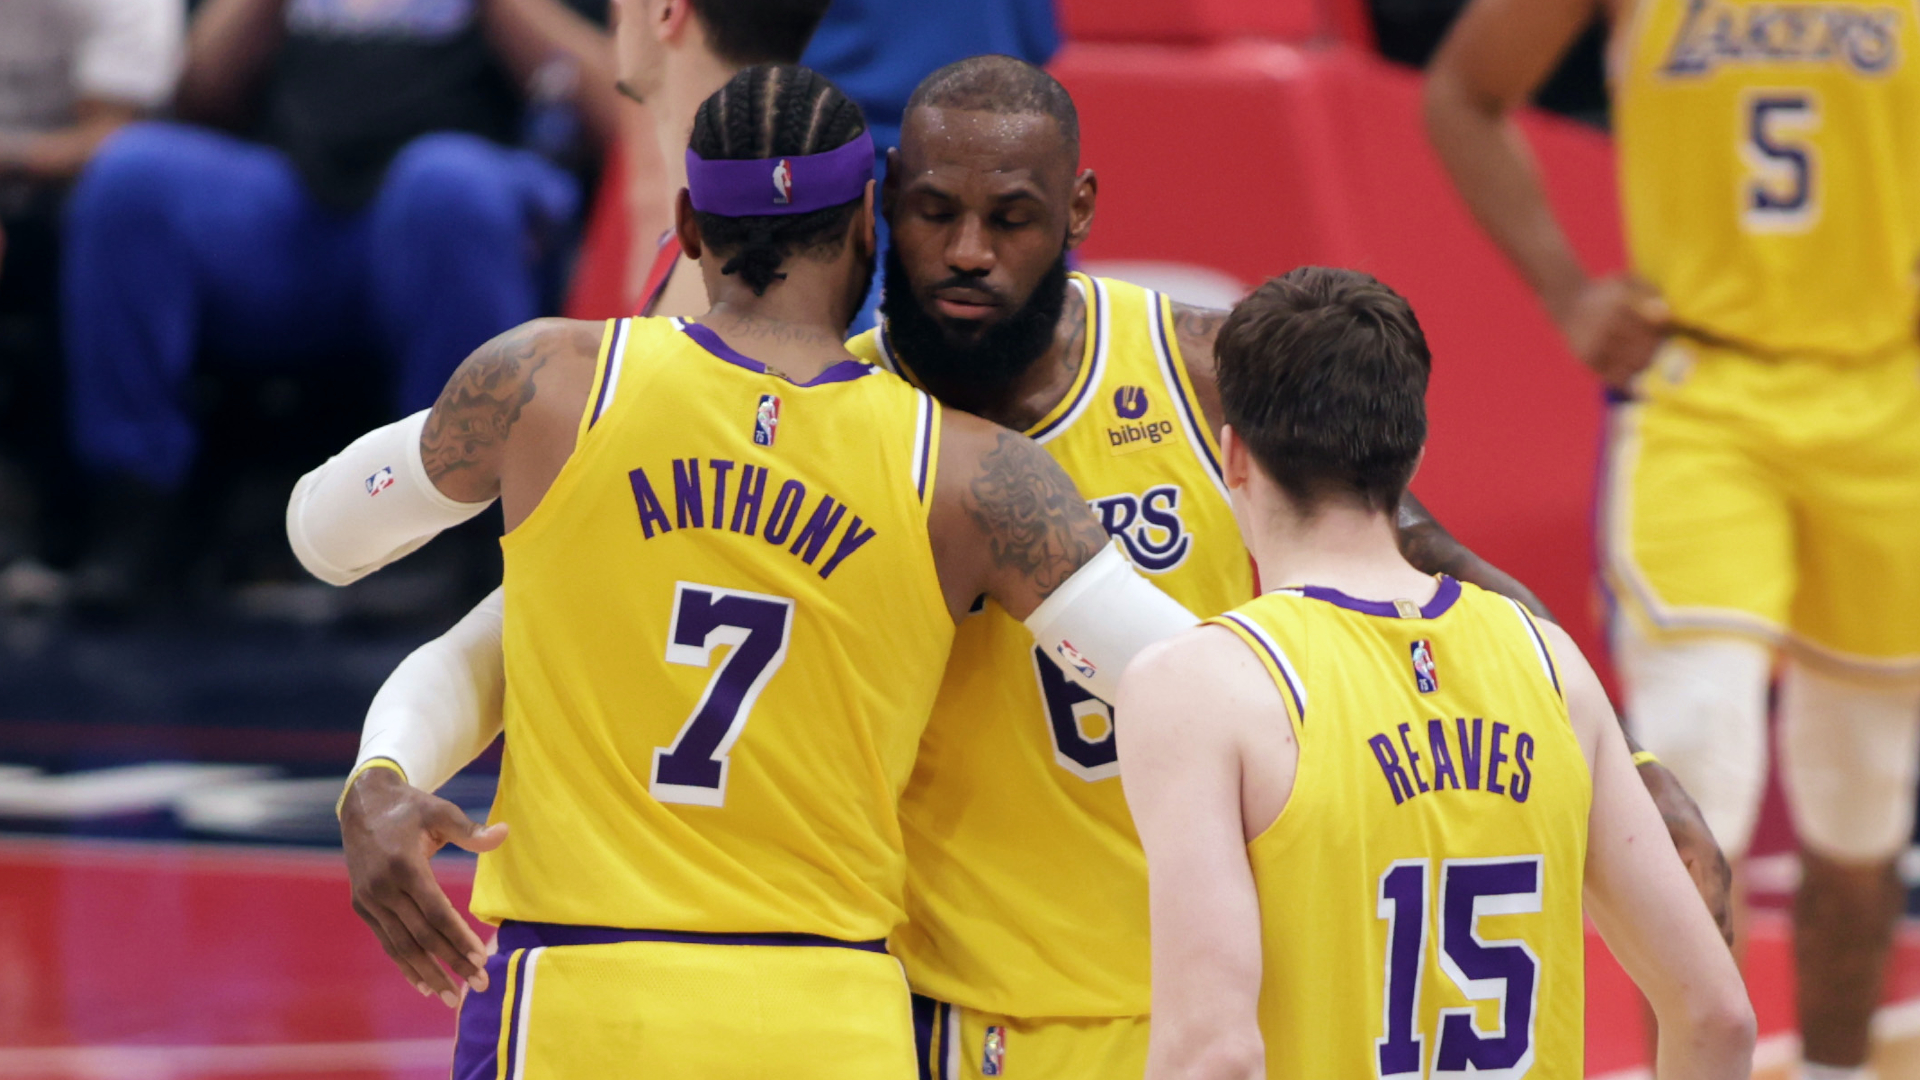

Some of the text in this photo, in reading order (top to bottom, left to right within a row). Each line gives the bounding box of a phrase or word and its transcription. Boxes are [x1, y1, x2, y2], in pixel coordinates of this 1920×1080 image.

[1742, 90, 1818, 230] 5
[1107, 419, 1173, 446] bibigo
[628, 458, 876, 580] ANTHONY
[649, 580, 796, 808] 7
[1030, 642, 1122, 783] 6
[1368, 717, 1534, 806] REAVES
[1375, 854, 1544, 1080] 15
